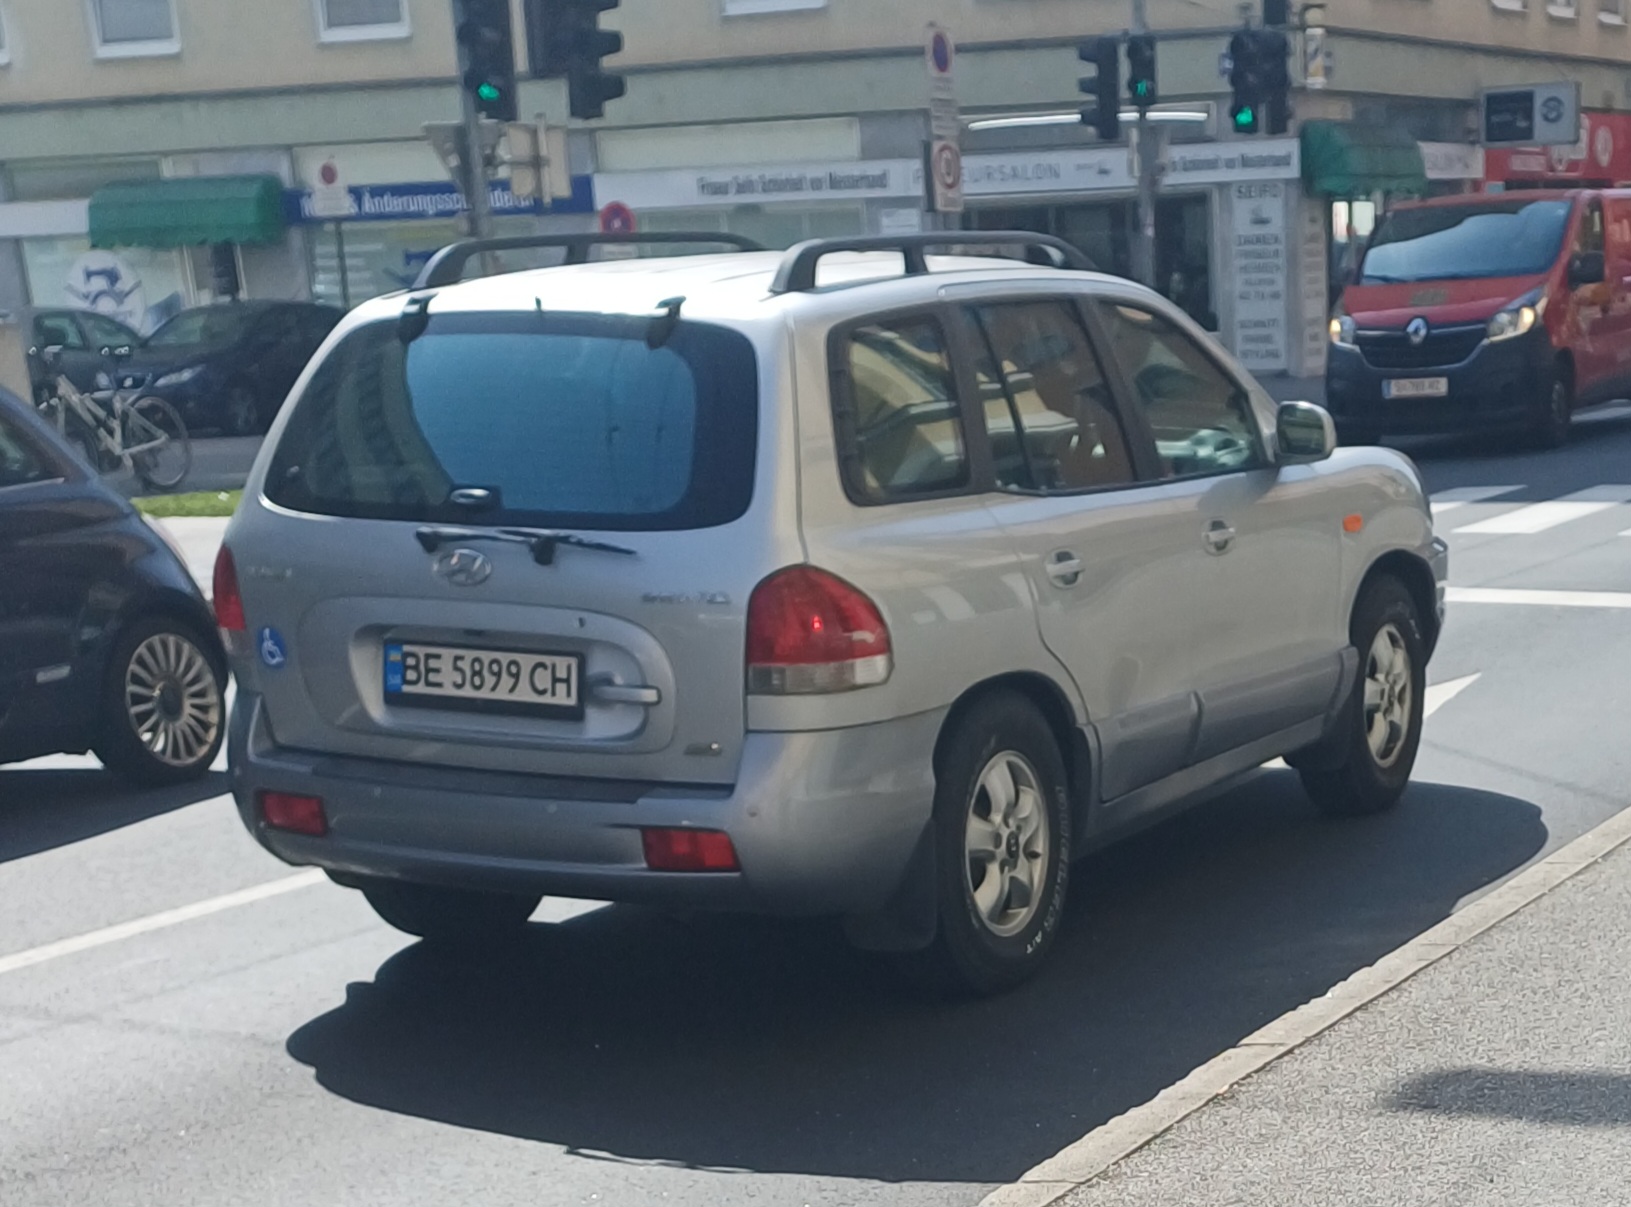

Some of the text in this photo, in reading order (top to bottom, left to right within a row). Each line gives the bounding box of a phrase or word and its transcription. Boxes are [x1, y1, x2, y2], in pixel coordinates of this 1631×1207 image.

[403, 651, 573, 699] BE 5899 CH
